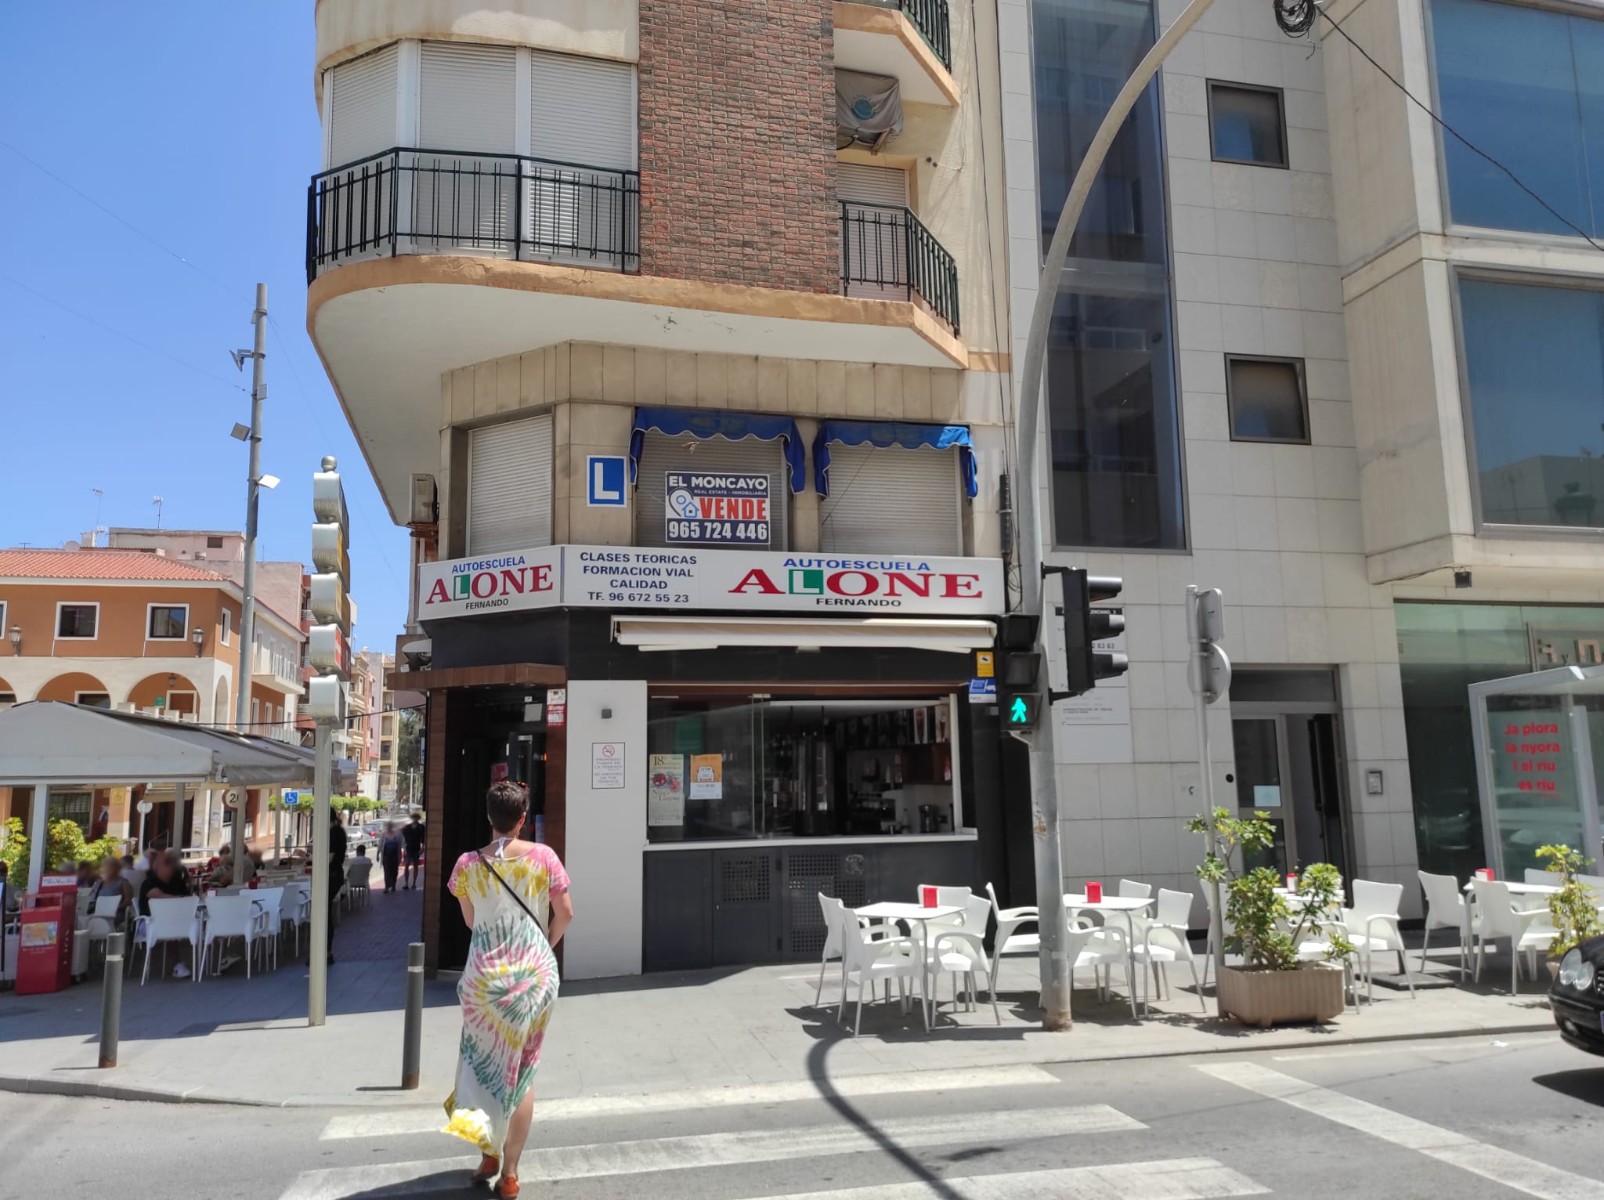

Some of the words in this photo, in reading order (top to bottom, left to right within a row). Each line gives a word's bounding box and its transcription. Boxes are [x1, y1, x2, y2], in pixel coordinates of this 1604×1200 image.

[594, 462, 620, 500] L
[669, 475, 688, 488] EL
[691, 476, 767, 489] MONCAYO
[699, 498, 767, 520] VENDE
[669, 521, 701, 538] 965
[704, 521, 732, 539] 724
[736, 522, 768, 540] 446
[451, 556, 526, 573] AUTOESCUELA
[580, 552, 630, 562] CLASES
[634, 554, 697, 564] TEORICAS
[783, 558, 931, 571] AUTOESCUELA
[583, 565, 662, 577] FORMACION
[665, 568, 694, 577] VIAL
[425, 564, 553, 605] ALONE
[610, 579, 668, 589] CALIDAD
[727, 568, 983, 598] ALONE
[465, 598, 509, 610] FERNANDO
[588, 592, 605, 601] TF.
[608, 592, 625, 602] 96
[628, 593, 651, 602] 672
[655, 594, 671, 603] 55
[674, 594, 690, 603] 23
[816, 597, 902, 607] FERNANDO
[1522, 722, 1558, 736] plora
